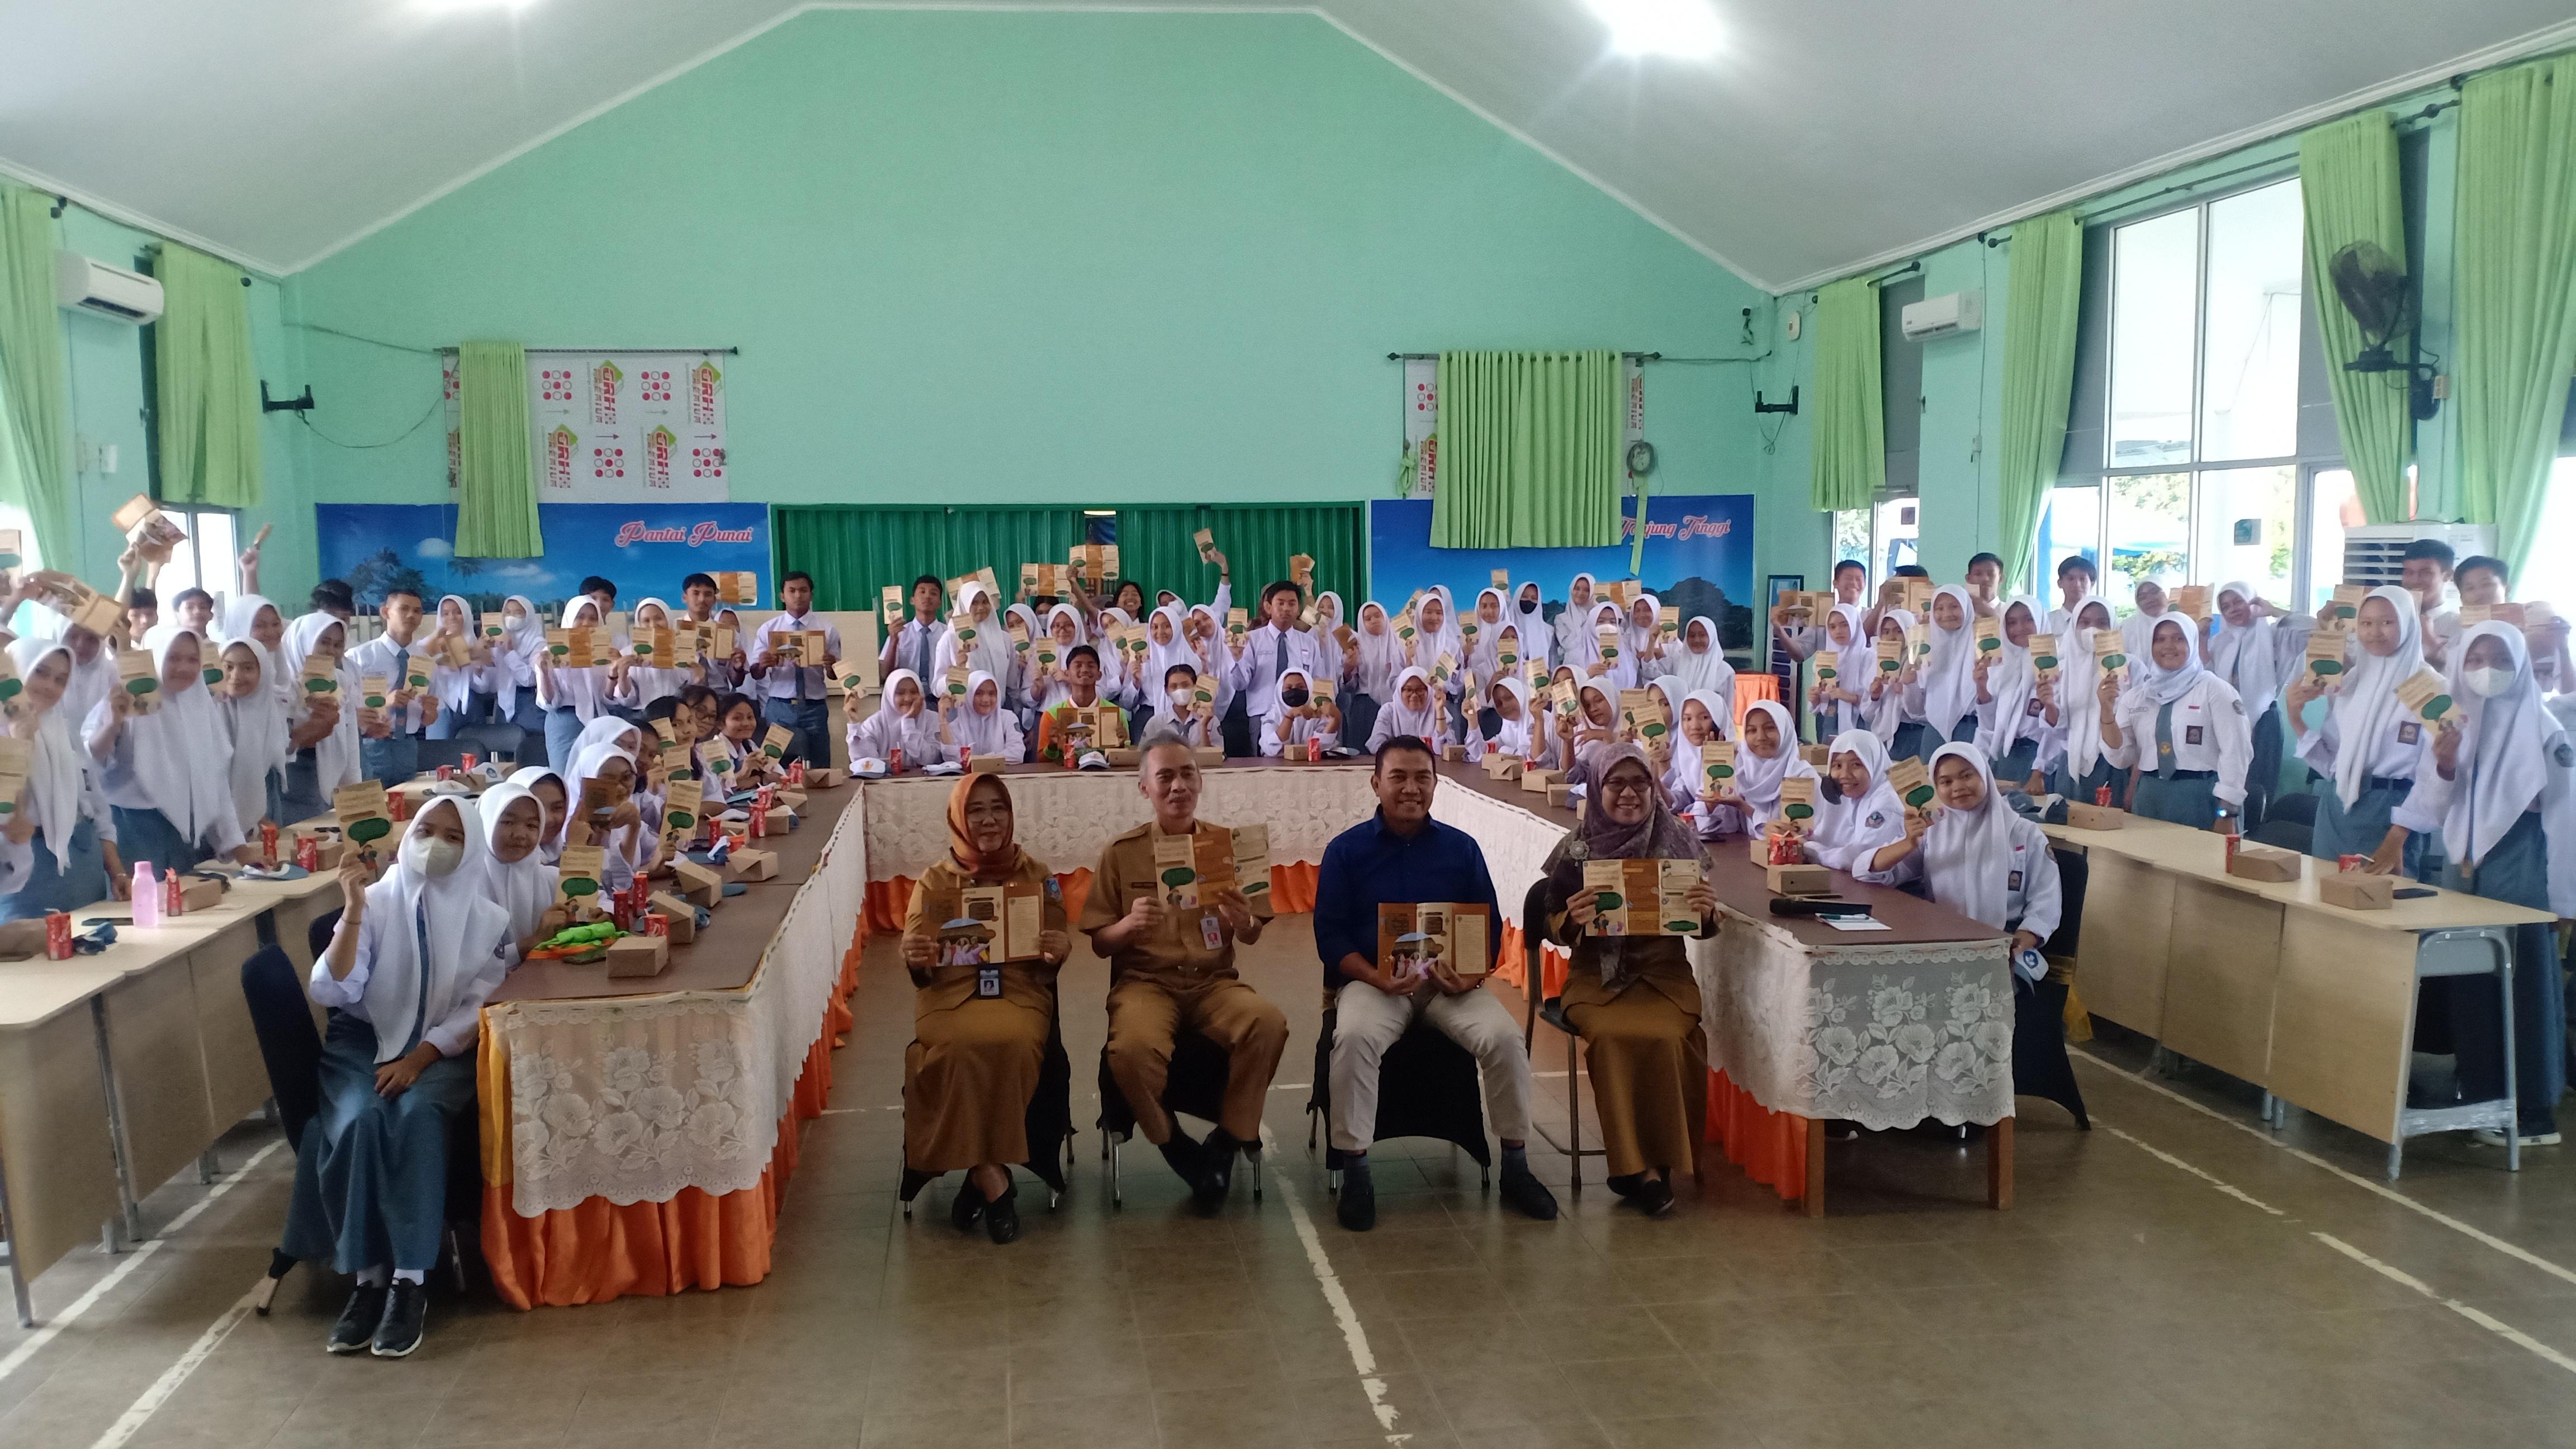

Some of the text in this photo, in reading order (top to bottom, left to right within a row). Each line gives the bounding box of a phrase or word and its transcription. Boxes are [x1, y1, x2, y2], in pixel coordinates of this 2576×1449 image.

[603, 367, 615, 412] GRH
[701, 368, 714, 412] GRH
[557, 431, 570, 475] GRH
[656, 432, 669, 476] GRH
[614, 520, 754, 547] Pantai Punai
[1678, 515, 1731, 541] Tinggi
